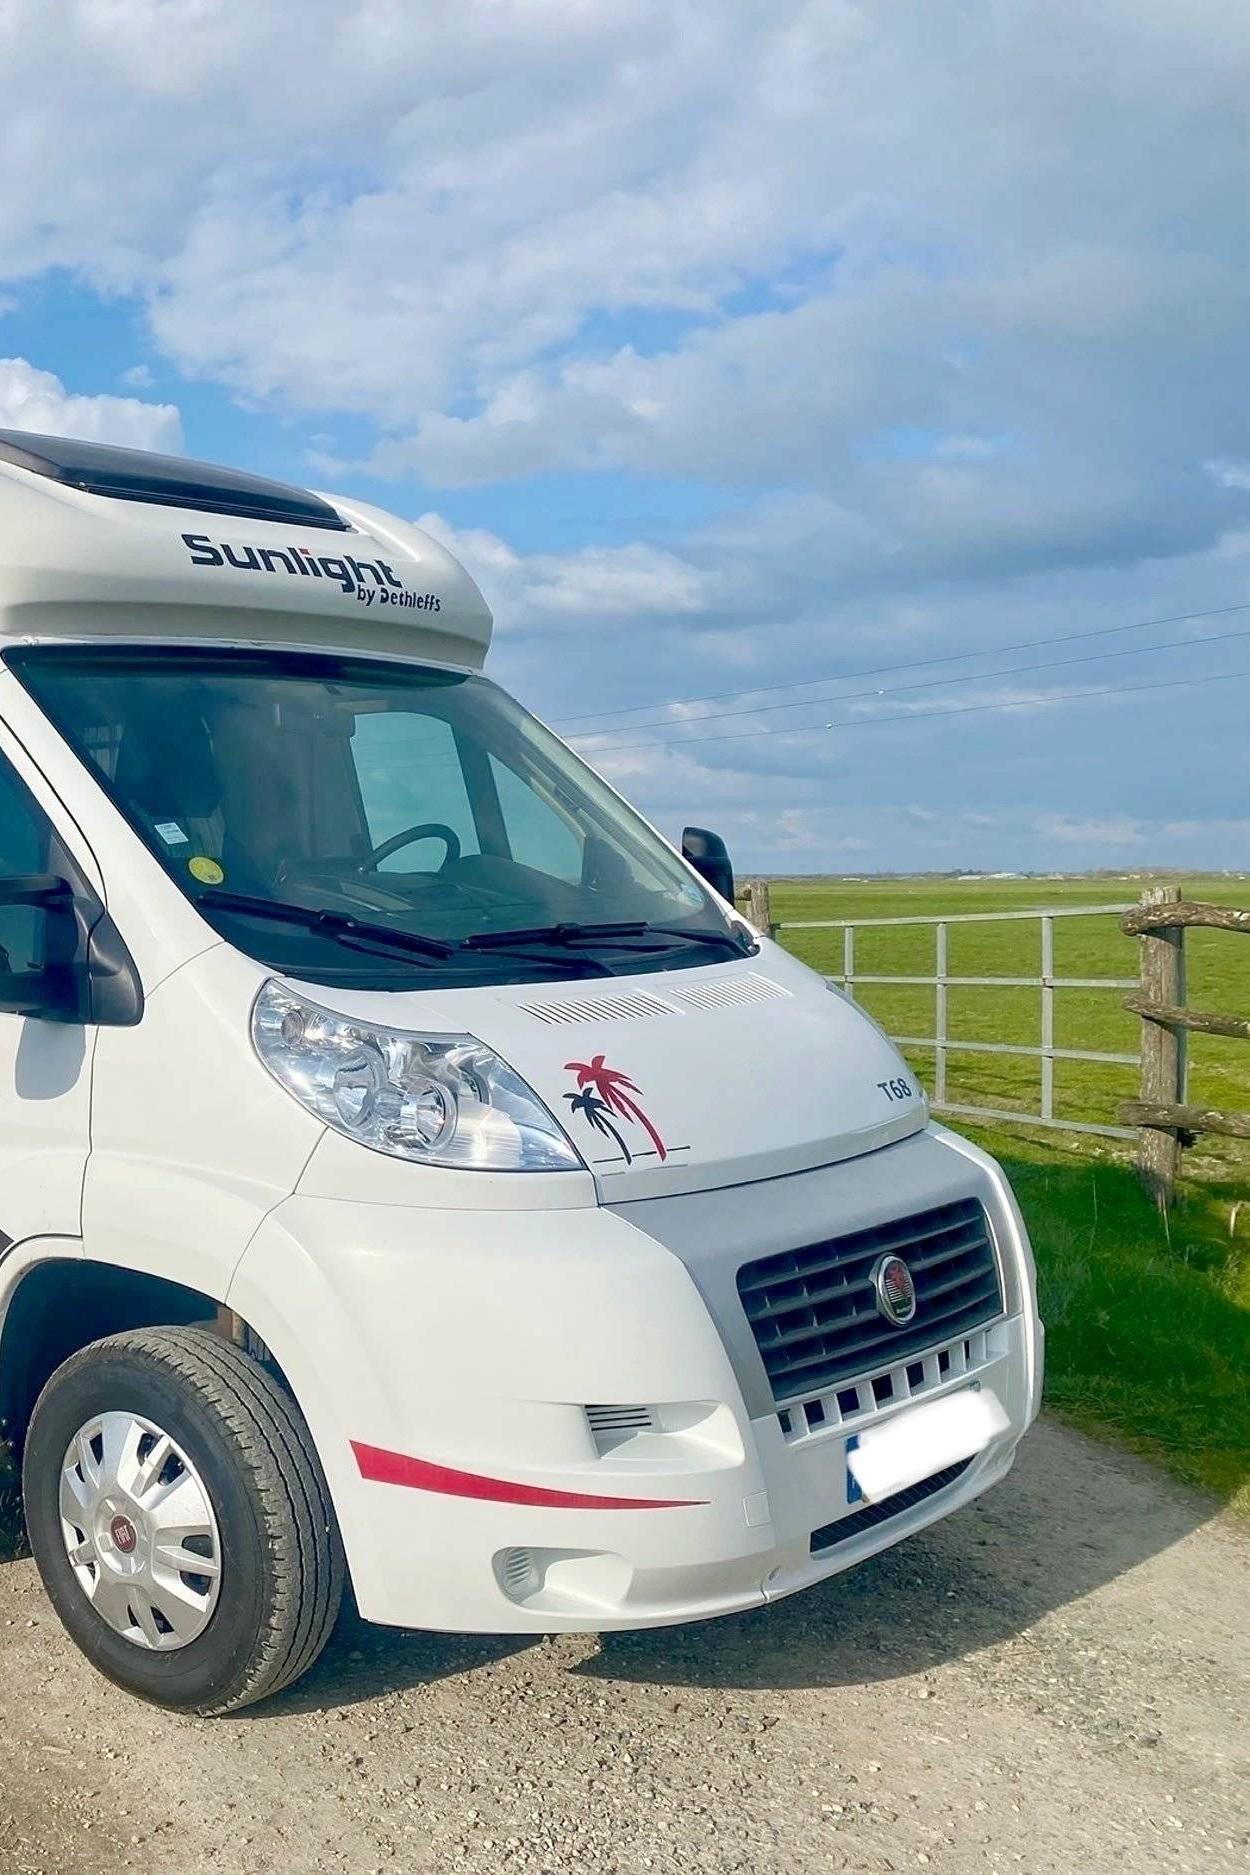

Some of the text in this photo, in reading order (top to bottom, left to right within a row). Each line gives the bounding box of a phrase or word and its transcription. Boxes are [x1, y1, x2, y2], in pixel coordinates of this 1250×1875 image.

[181, 533, 403, 593] Sunlight
[356, 583, 441, 613] by Dethleffs
[876, 1077, 913, 1102] T68
